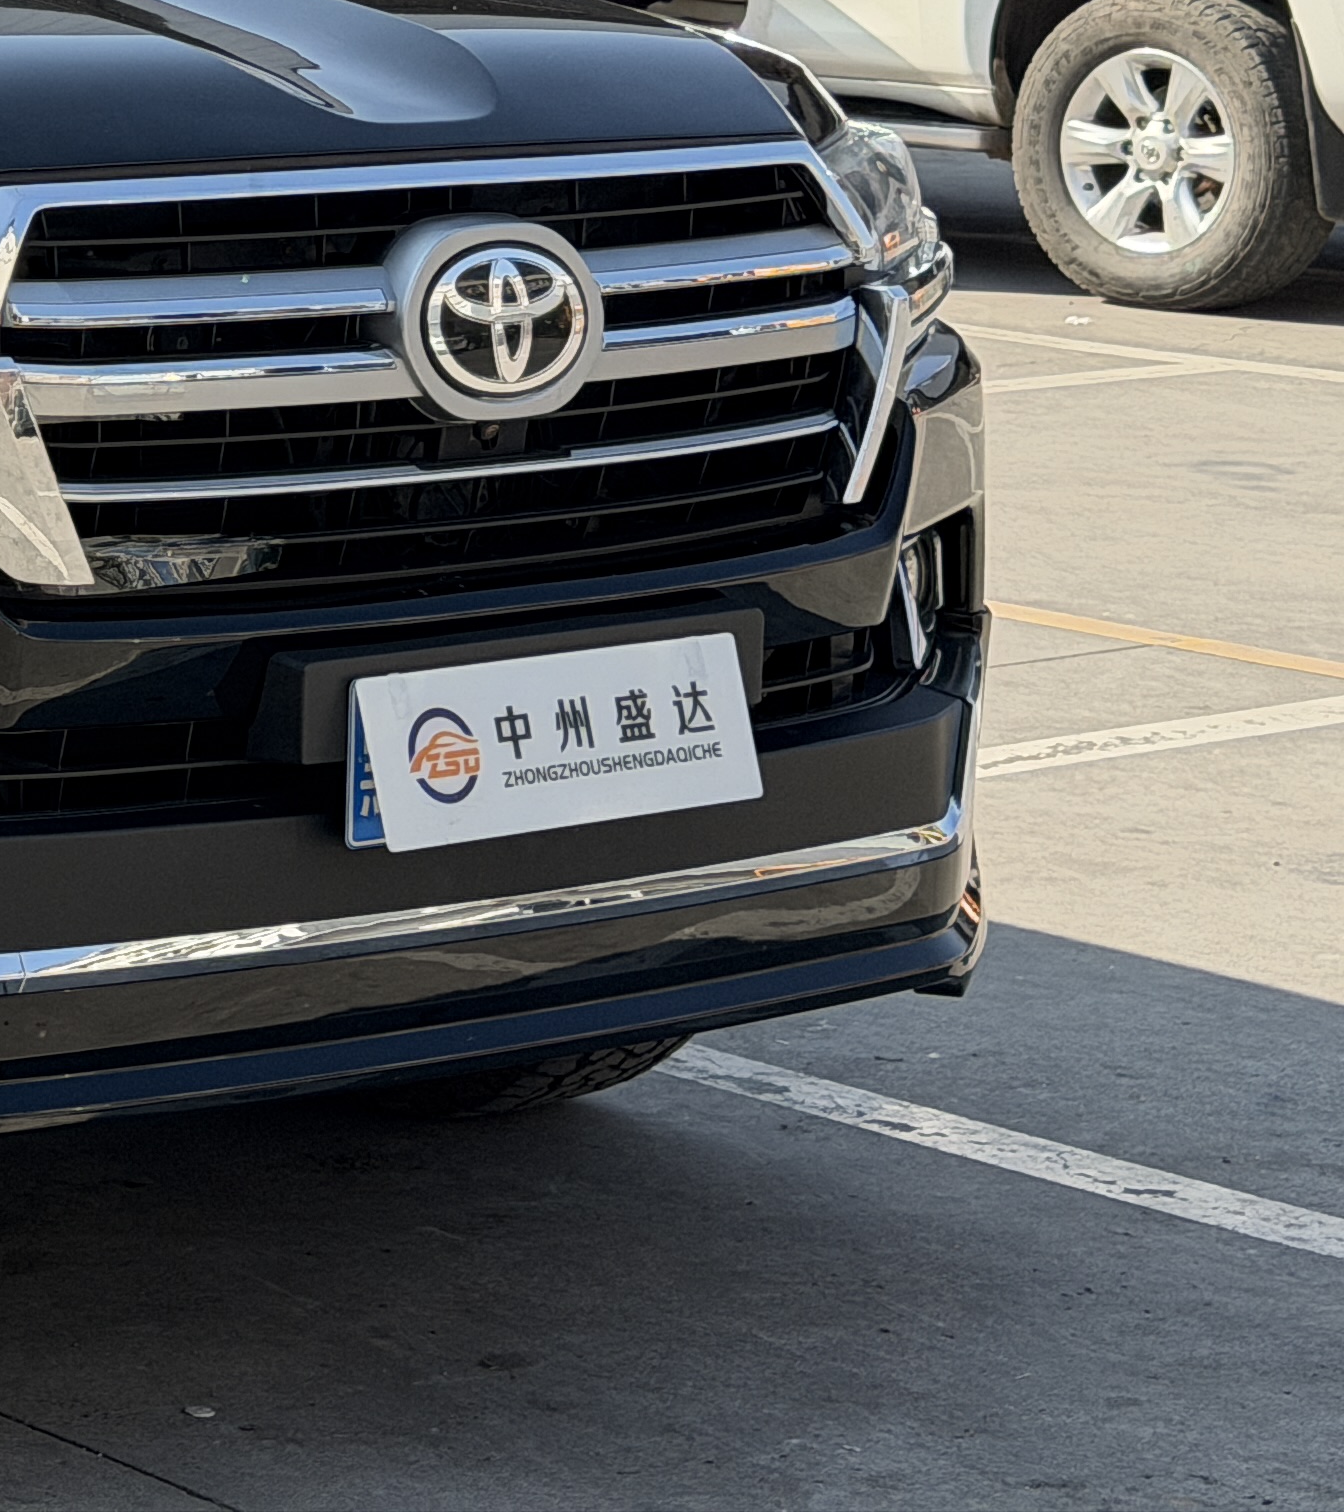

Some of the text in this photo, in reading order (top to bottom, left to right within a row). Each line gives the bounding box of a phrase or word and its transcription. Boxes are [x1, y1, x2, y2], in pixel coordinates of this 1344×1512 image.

[493, 680, 716, 760] 中州盛达
[501, 741, 724, 789] ZHONGZHOUSHENGDAQICHE
